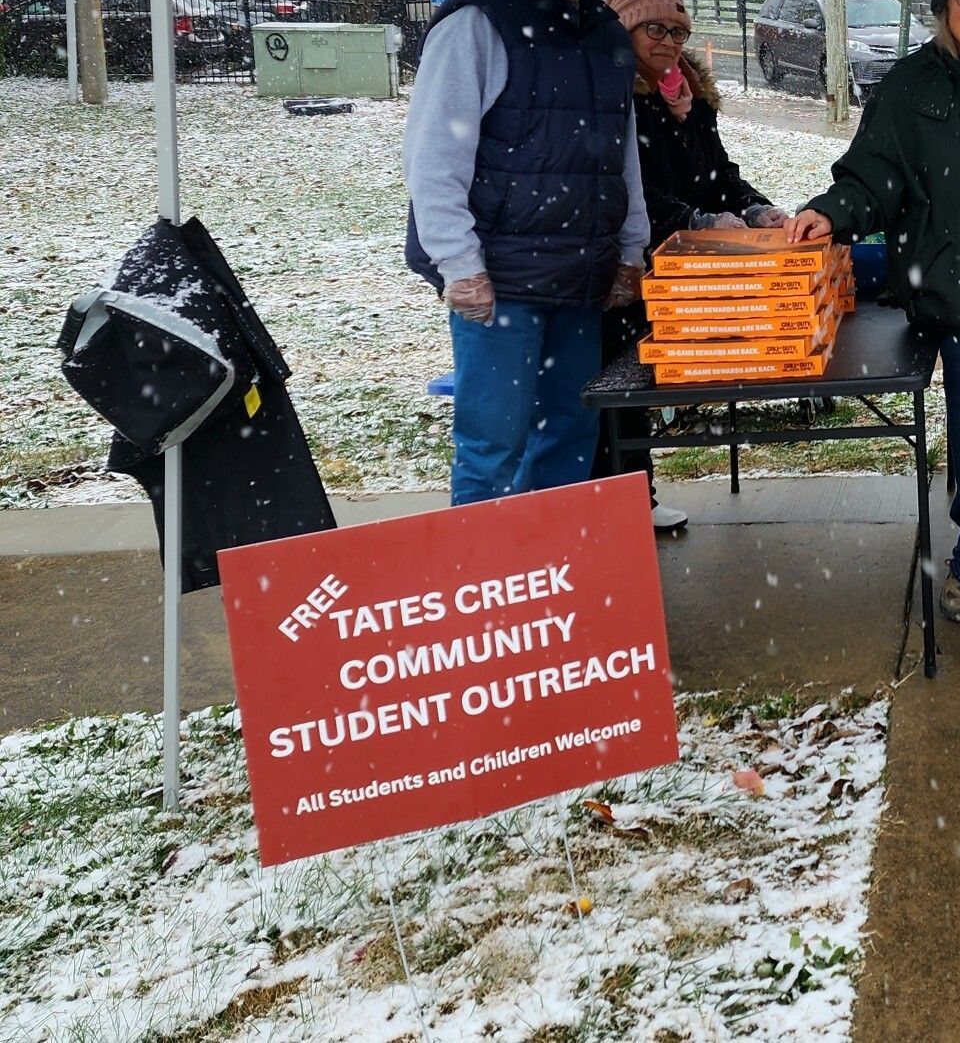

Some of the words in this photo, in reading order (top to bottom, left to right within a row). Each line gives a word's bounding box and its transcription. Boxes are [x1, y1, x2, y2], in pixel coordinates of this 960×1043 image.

[278, 574, 349, 643] FREE
[329, 591, 447, 640] TATES
[455, 563, 574, 615] CREEK
[339, 612, 576, 691] COMMUNITY
[269, 692, 452, 758] STUDENT
[461, 643, 656, 716] OUTREACH
[296, 792, 326, 816] All
[329, 772, 424, 808] Students
[428, 760, 466, 786] and
[470, 740, 552, 776] Children
[554, 717, 642, 753] Welcome
